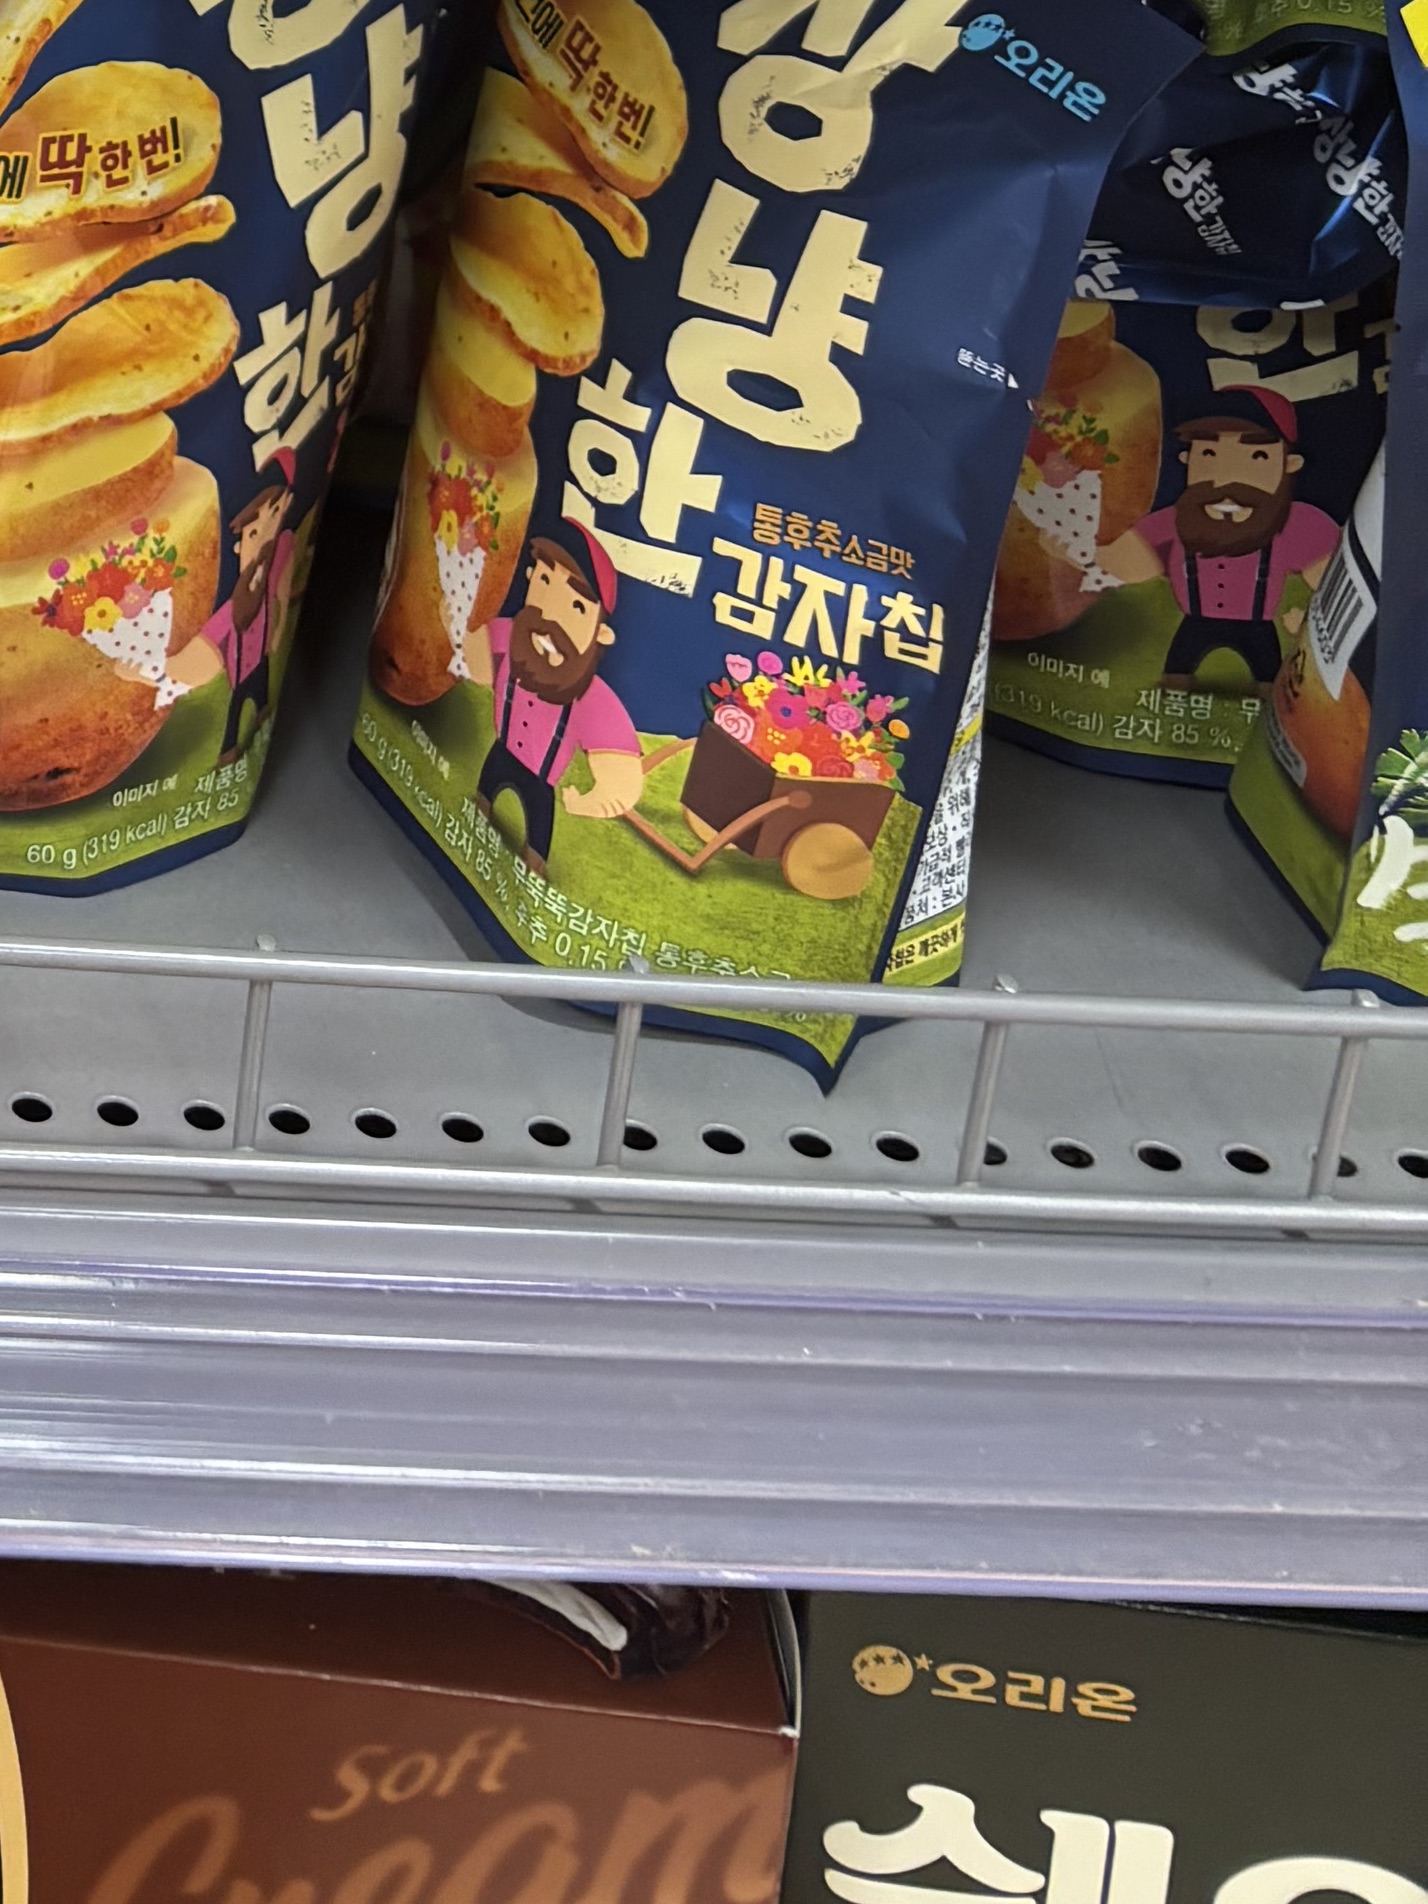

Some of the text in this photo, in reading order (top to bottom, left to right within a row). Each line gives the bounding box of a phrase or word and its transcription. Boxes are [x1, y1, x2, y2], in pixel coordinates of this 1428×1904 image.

[559, 14, 608, 93] 딱
[590, 67, 650, 151] 한번!
[993, 41, 1108, 122] 오리온
[37, 133, 94, 194] 딱
[98, 117, 182, 190] 한번!
[752, 503, 916, 581] 통후추소금맛
[710, 538, 946, 674] 감자칩
[1026, 651, 1078, 681] 이미지
[1136, 688, 1214, 719] 제품명
[1048, 700, 1200, 743] kcal) 감자 85
[27, 789, 239, 870] 60 g (319 kcal) 감자 85
[112, 777, 159, 809] 이미지
[359, 711, 608, 969] 60 감자 85 0.15
[512, 851, 646, 958] 무뚝뚝감자칩
[931, 1661, 1139, 1723] 오리온
[310, 1727, 534, 1823] Soft
